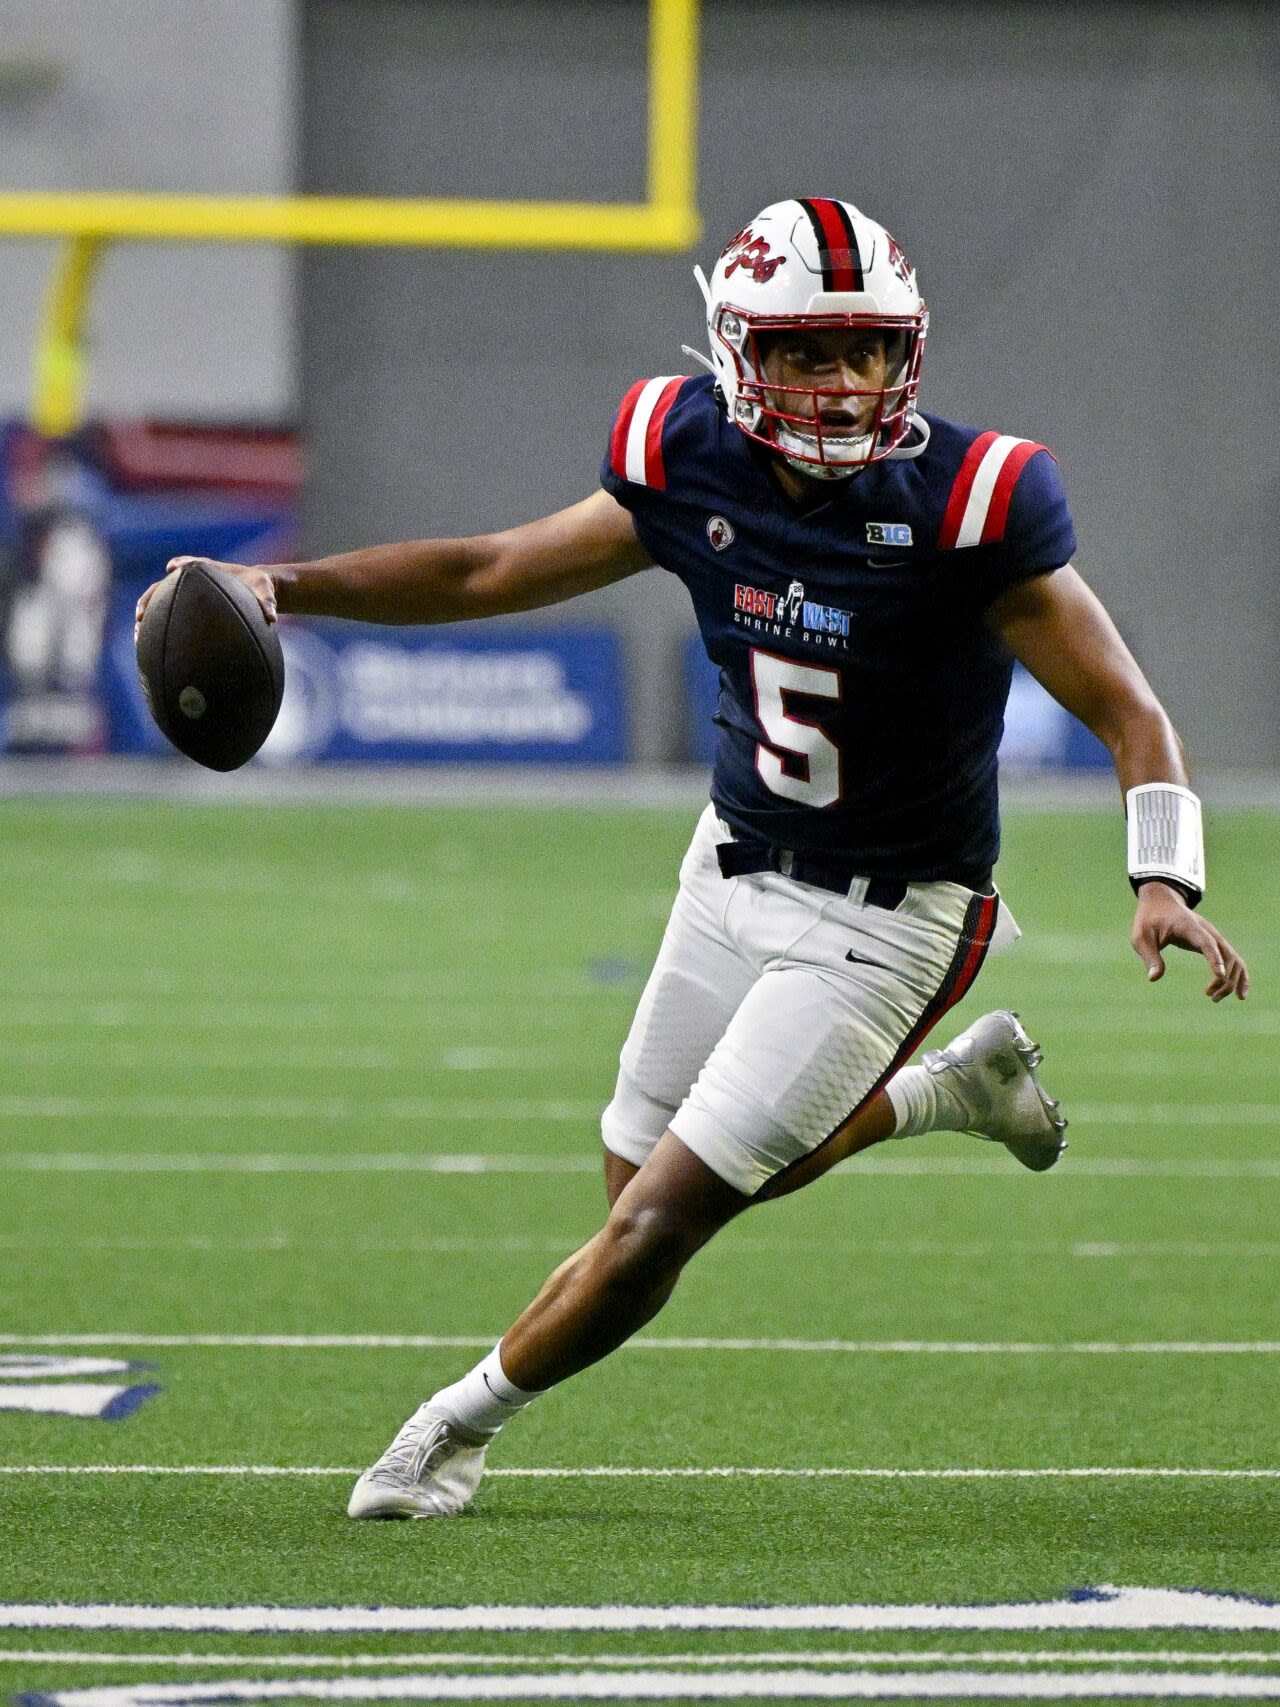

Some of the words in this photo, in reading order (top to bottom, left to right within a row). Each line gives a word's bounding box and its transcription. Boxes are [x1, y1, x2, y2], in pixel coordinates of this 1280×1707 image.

[734, 583, 778, 619] EAST
[802, 600, 853, 637] WEST
[734, 612, 793, 638] SHRINE
[803, 631, 849, 649] BOWL
[750, 648, 844, 808] 5
